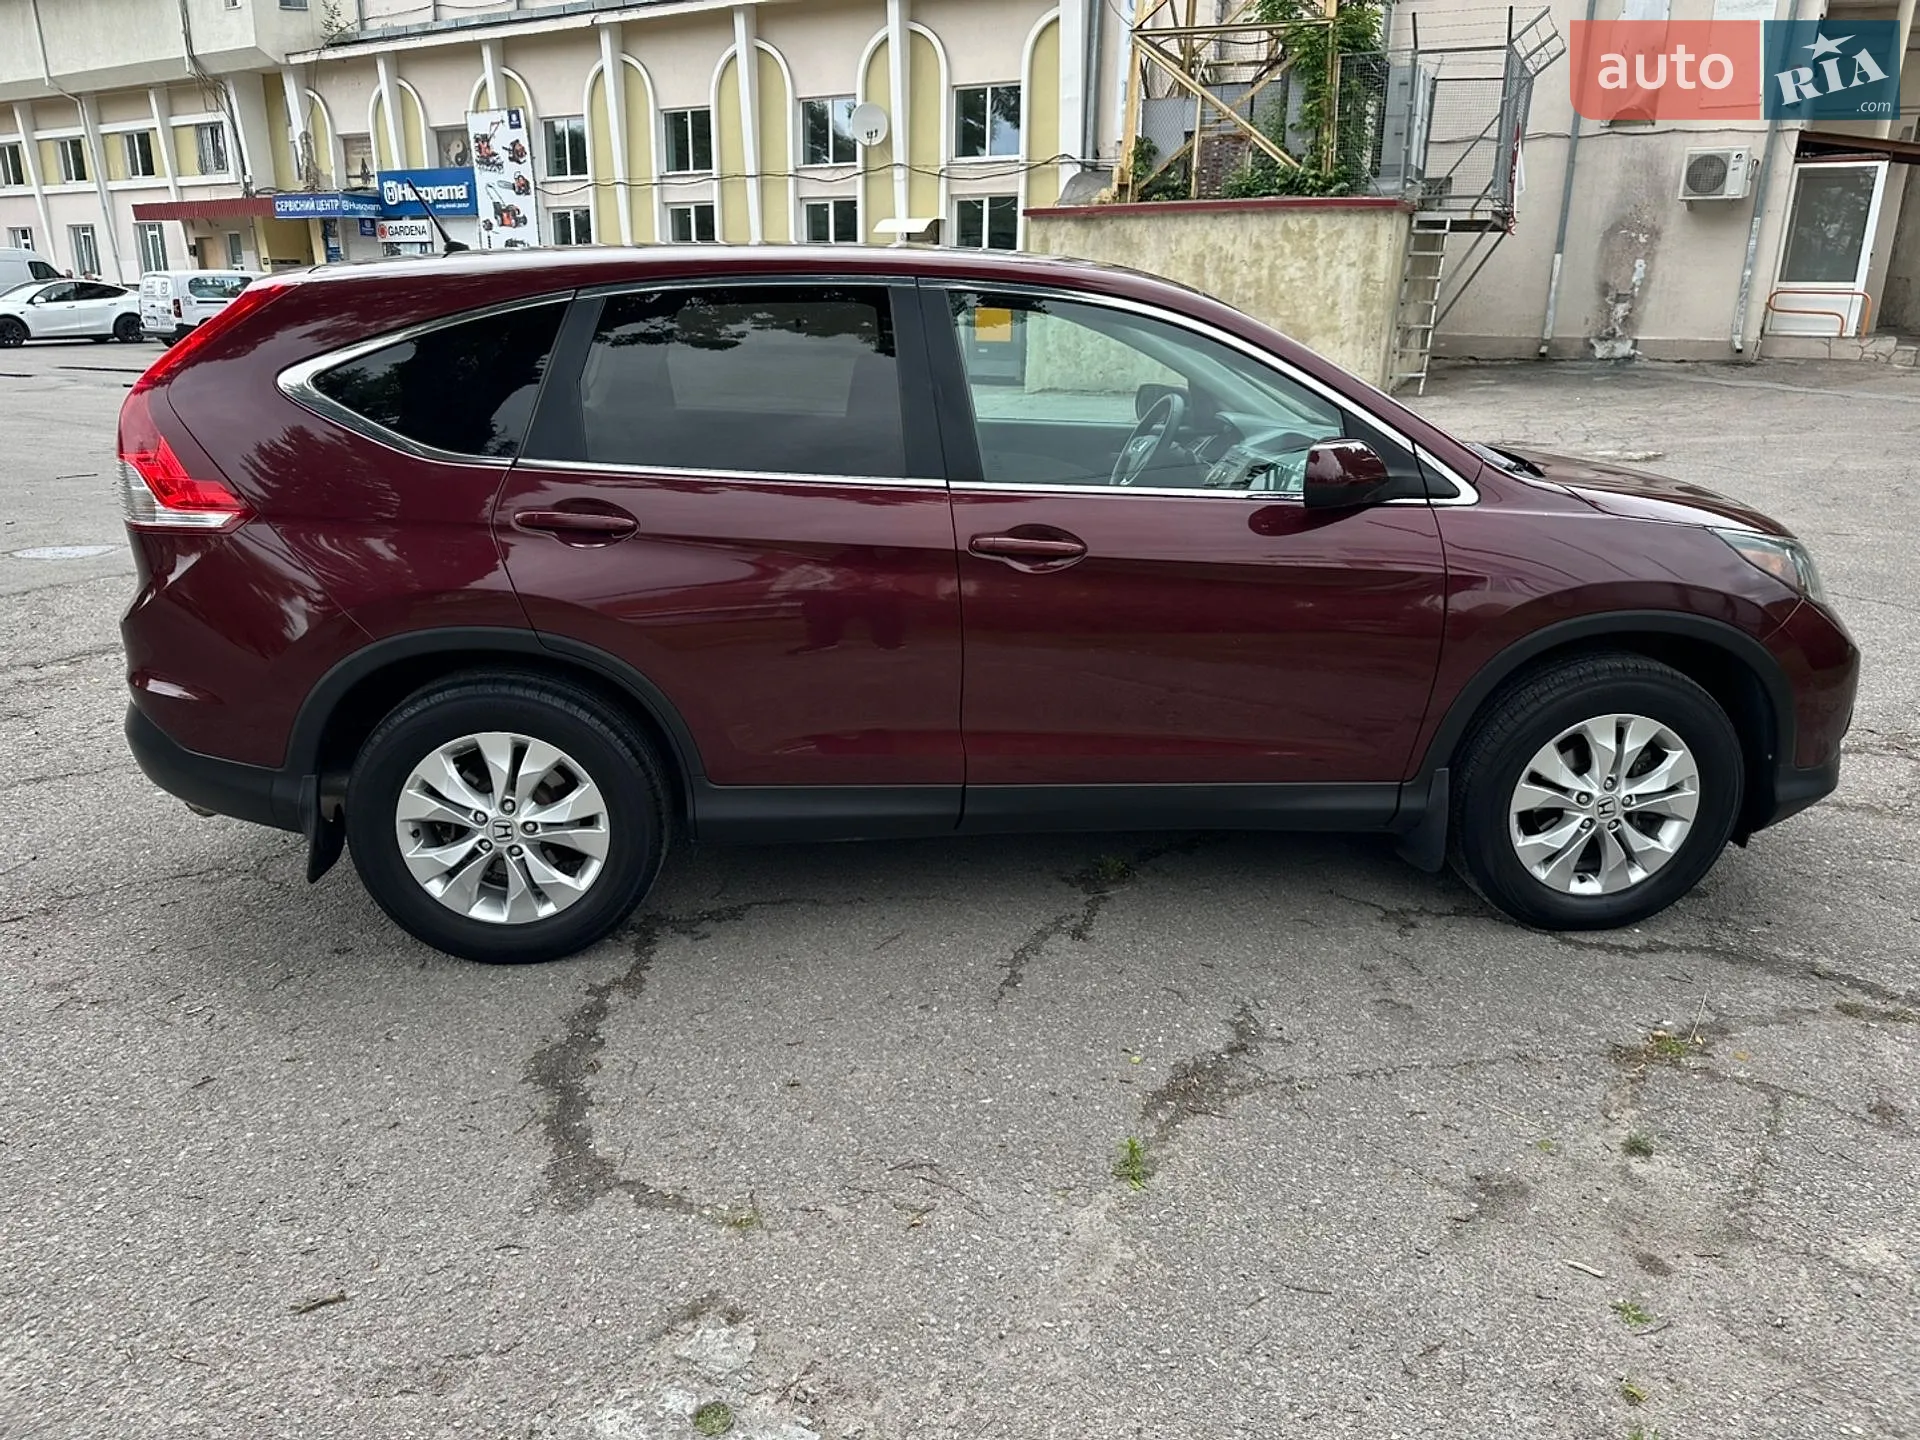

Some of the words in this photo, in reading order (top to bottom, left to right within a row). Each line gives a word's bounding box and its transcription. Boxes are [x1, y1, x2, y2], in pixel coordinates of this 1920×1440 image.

[275, 198, 315, 212] СЕРВІСНИЙ
[316, 199, 339, 212] ЦЕНТР
[388, 225, 427, 236] GARDENA
